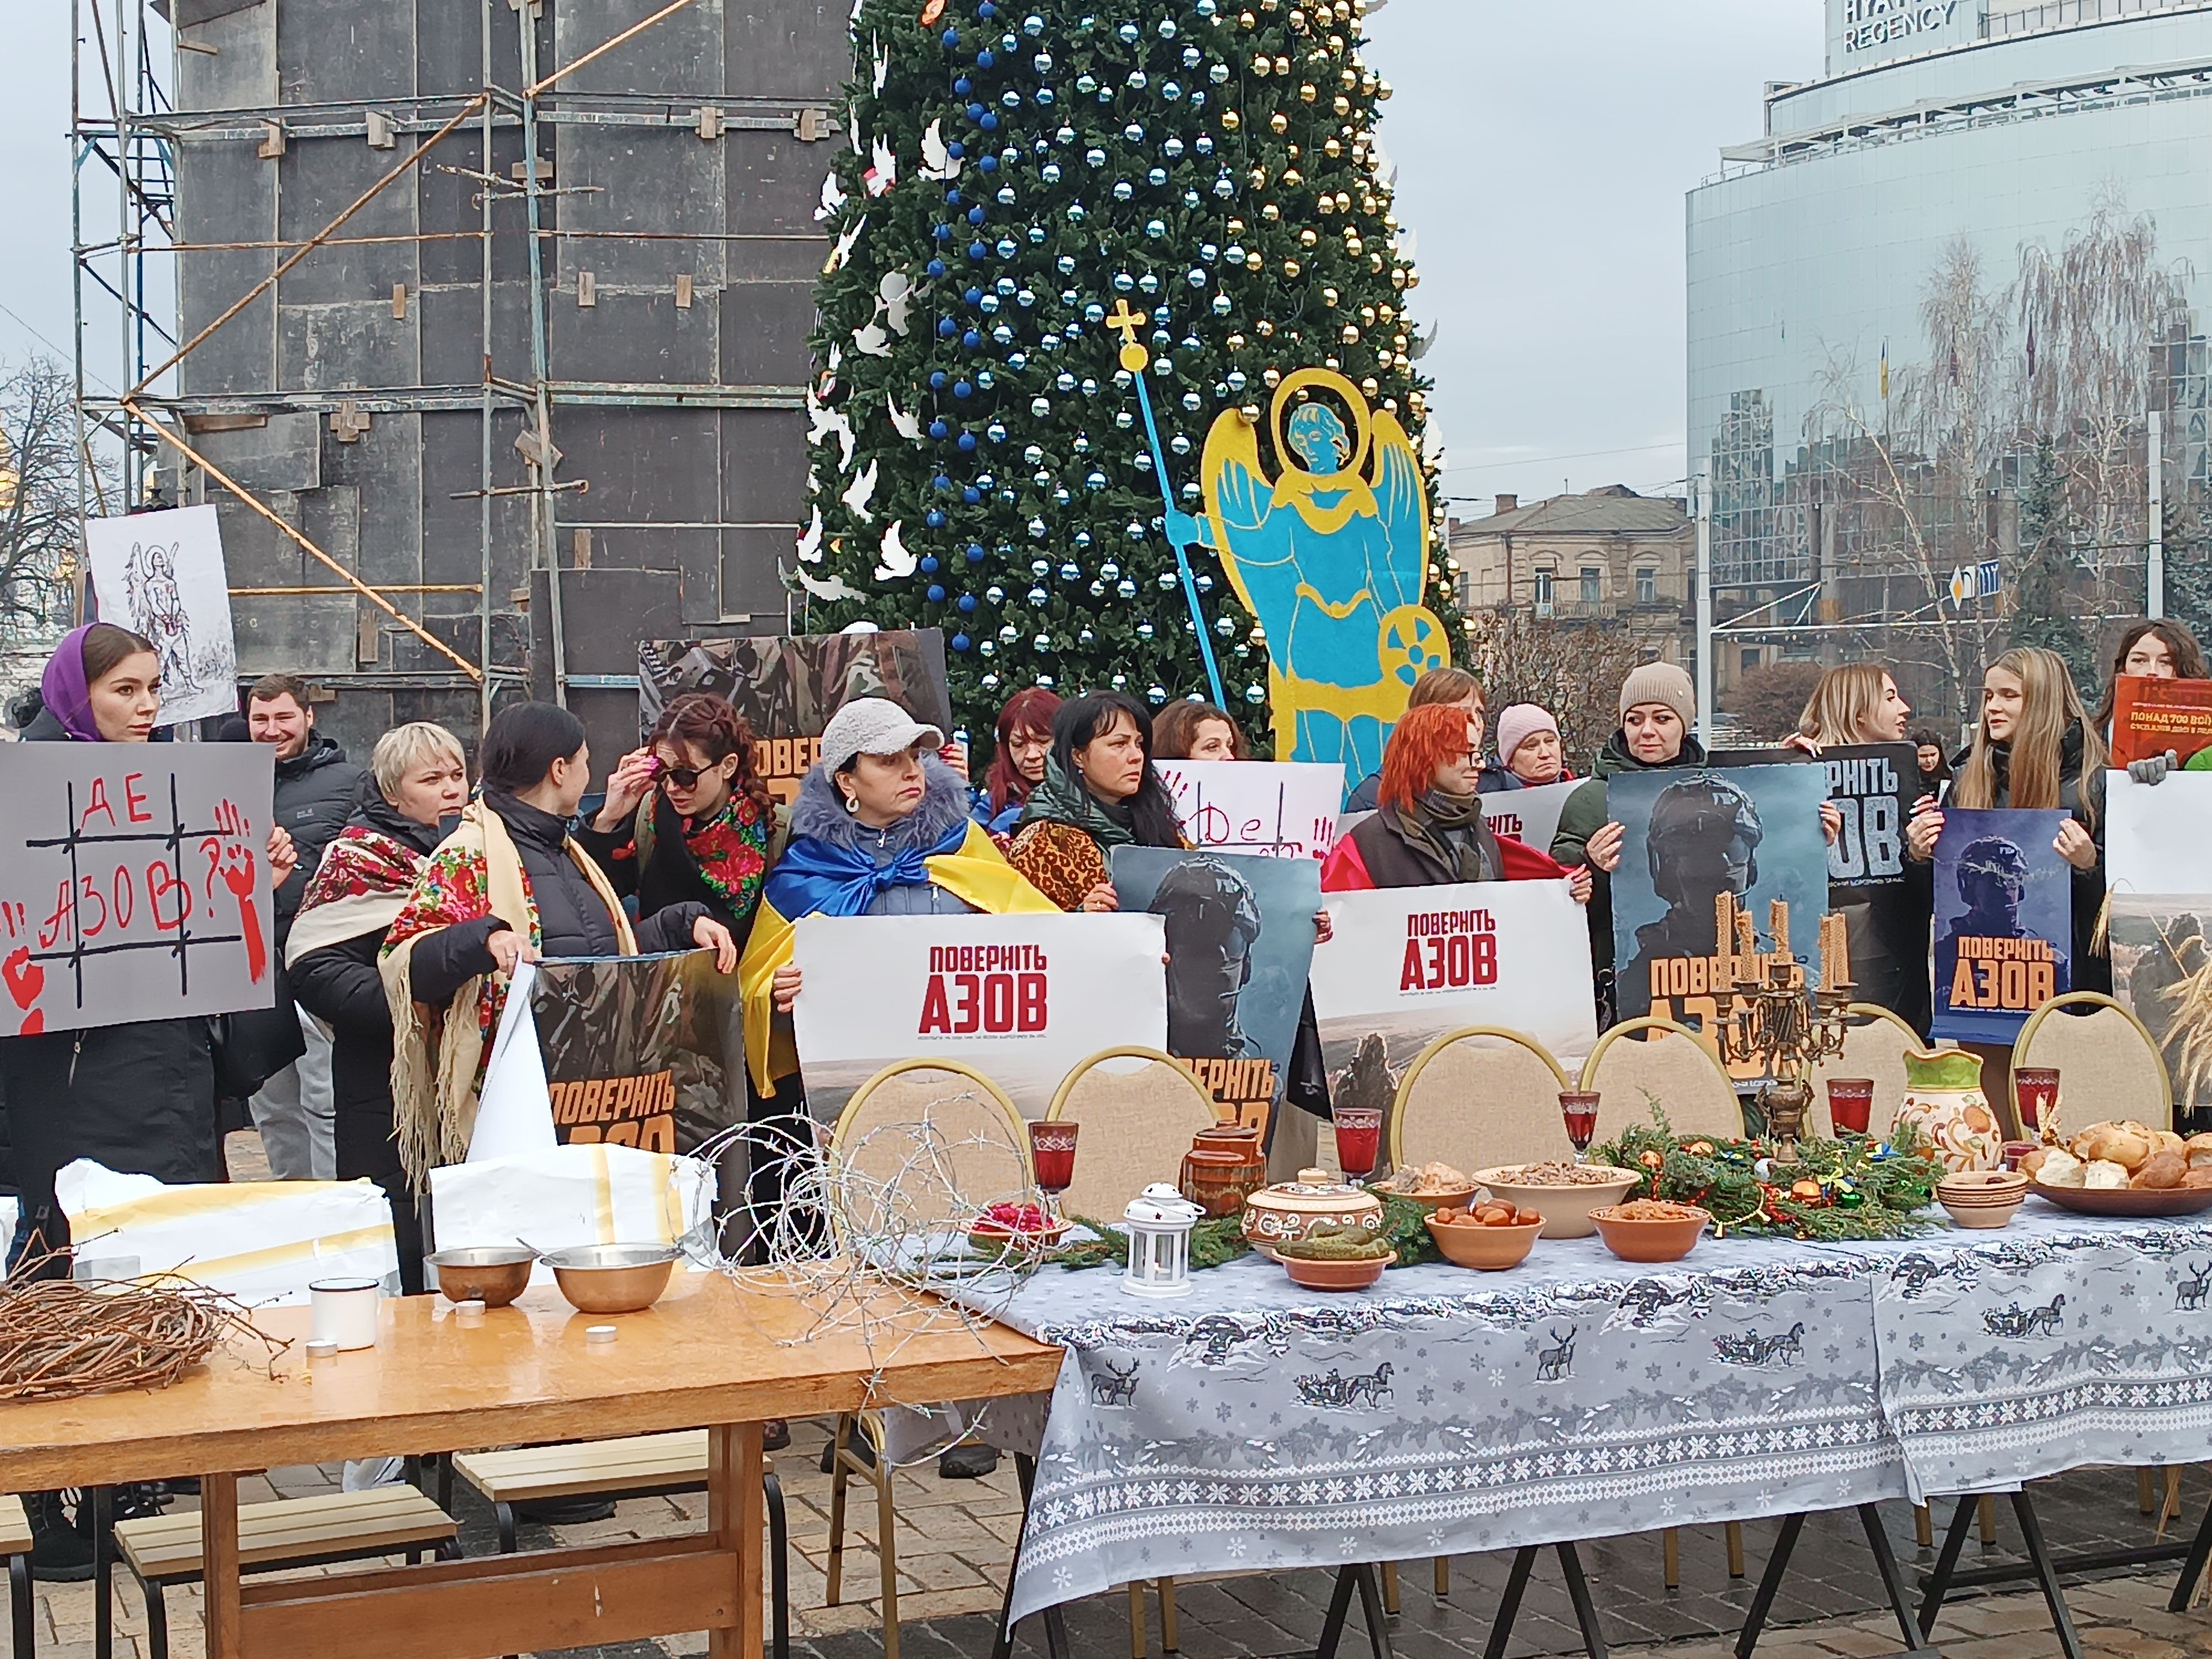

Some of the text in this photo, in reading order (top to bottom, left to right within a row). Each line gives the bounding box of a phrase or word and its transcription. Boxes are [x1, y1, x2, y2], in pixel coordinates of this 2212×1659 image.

[1844, 1, 1957, 53] REGENCY
[2131, 712, 2168, 723] ПОНАД
[2169, 714, 2188, 724] 700
[80, 773, 152, 830] ДЕ
[1825, 758, 1898, 796] РНІТЬ
[1407, 909, 1495, 937] ПОВЕРНІТЬ
[1958, 936, 2053, 961] ПОВЕРНІТЬ
[930, 945, 1047, 972] ПОВЕРНІТЬ
[1400, 933, 1497, 990] АЗОВ
[1949, 958, 2054, 1009] АЗОВ
[919, 973, 1047, 1034] АЗОВ
[549, 1069, 675, 1125] ПОВЕРНІТЬ
